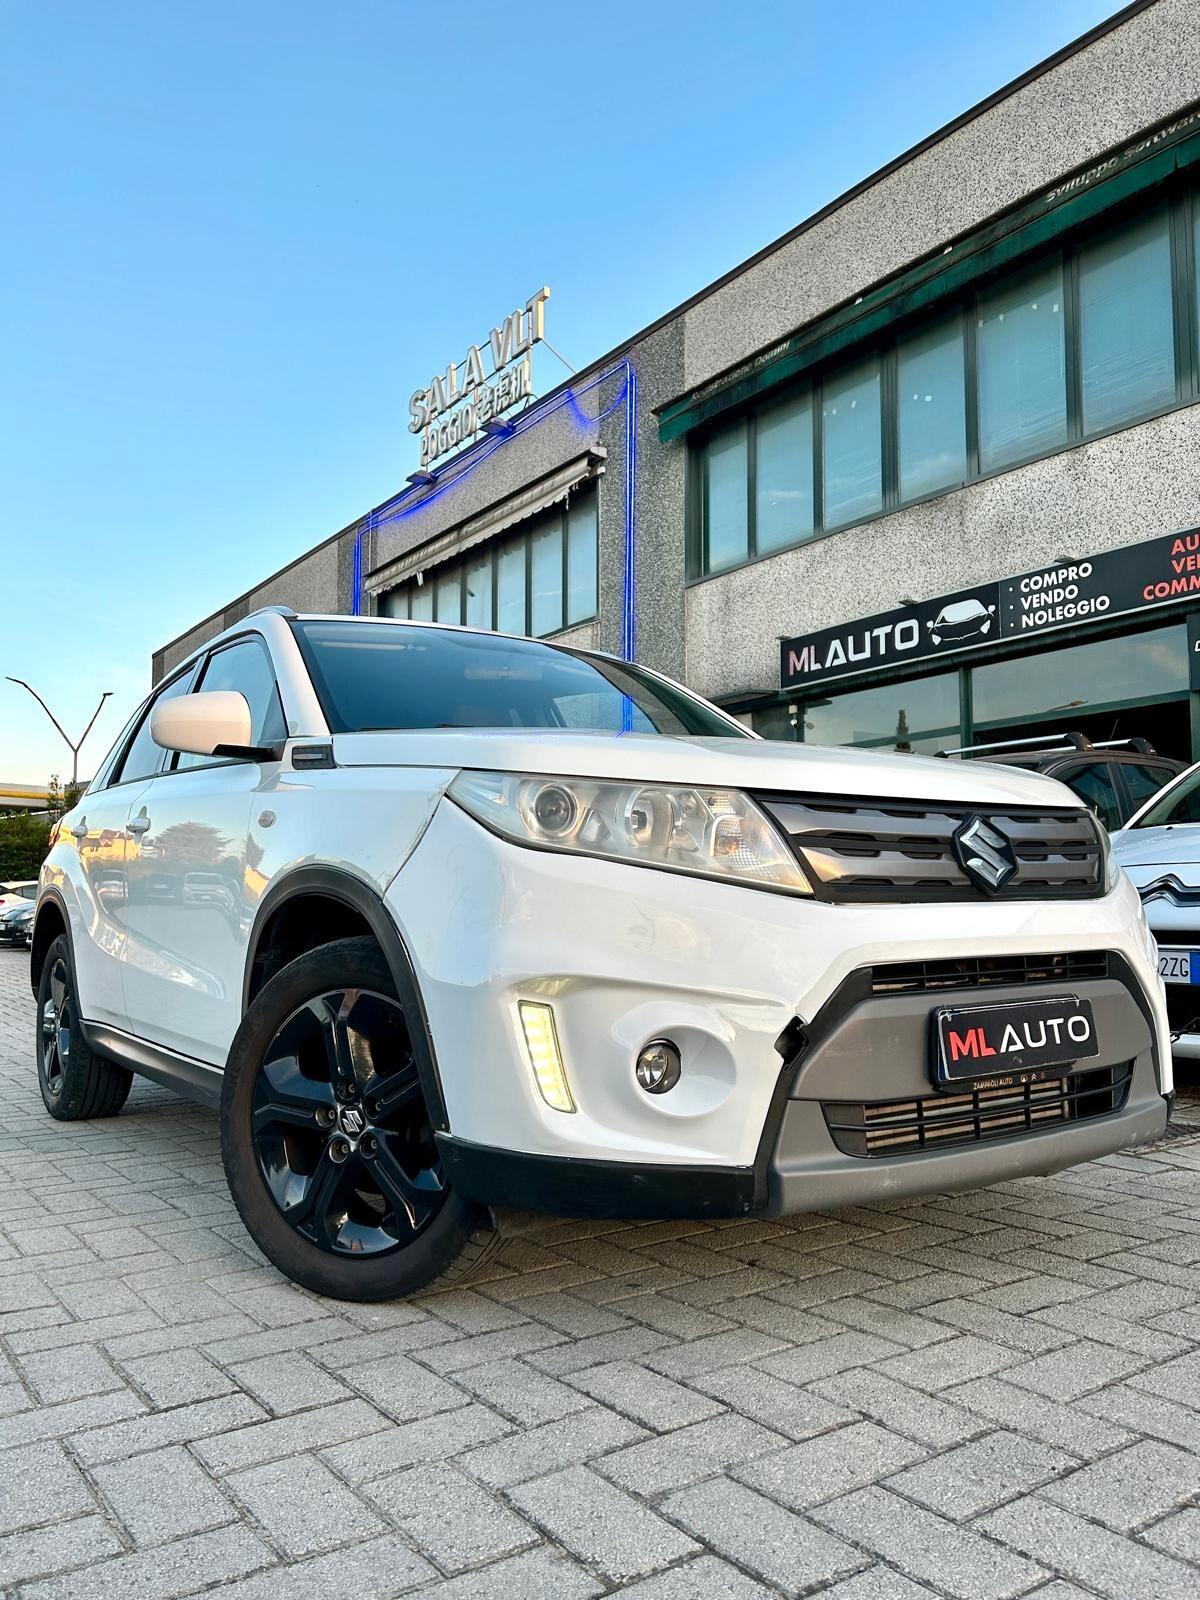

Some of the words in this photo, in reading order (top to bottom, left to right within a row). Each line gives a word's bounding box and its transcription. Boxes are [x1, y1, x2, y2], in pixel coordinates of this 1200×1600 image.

[408, 345, 485, 434] SALA
[489, 286, 551, 371] VLT
[420, 403, 477, 467] POGGIO
[1020, 562, 1093, 593] COMPRO
[1171, 554, 1200, 574] VE
[1020, 584, 1079, 610] VENDO
[1021, 595, 1110, 628] NOLEGGIO
[1158, 957, 1189, 977] 2ZG
[999, 1076, 1013, 1087] AUTO
